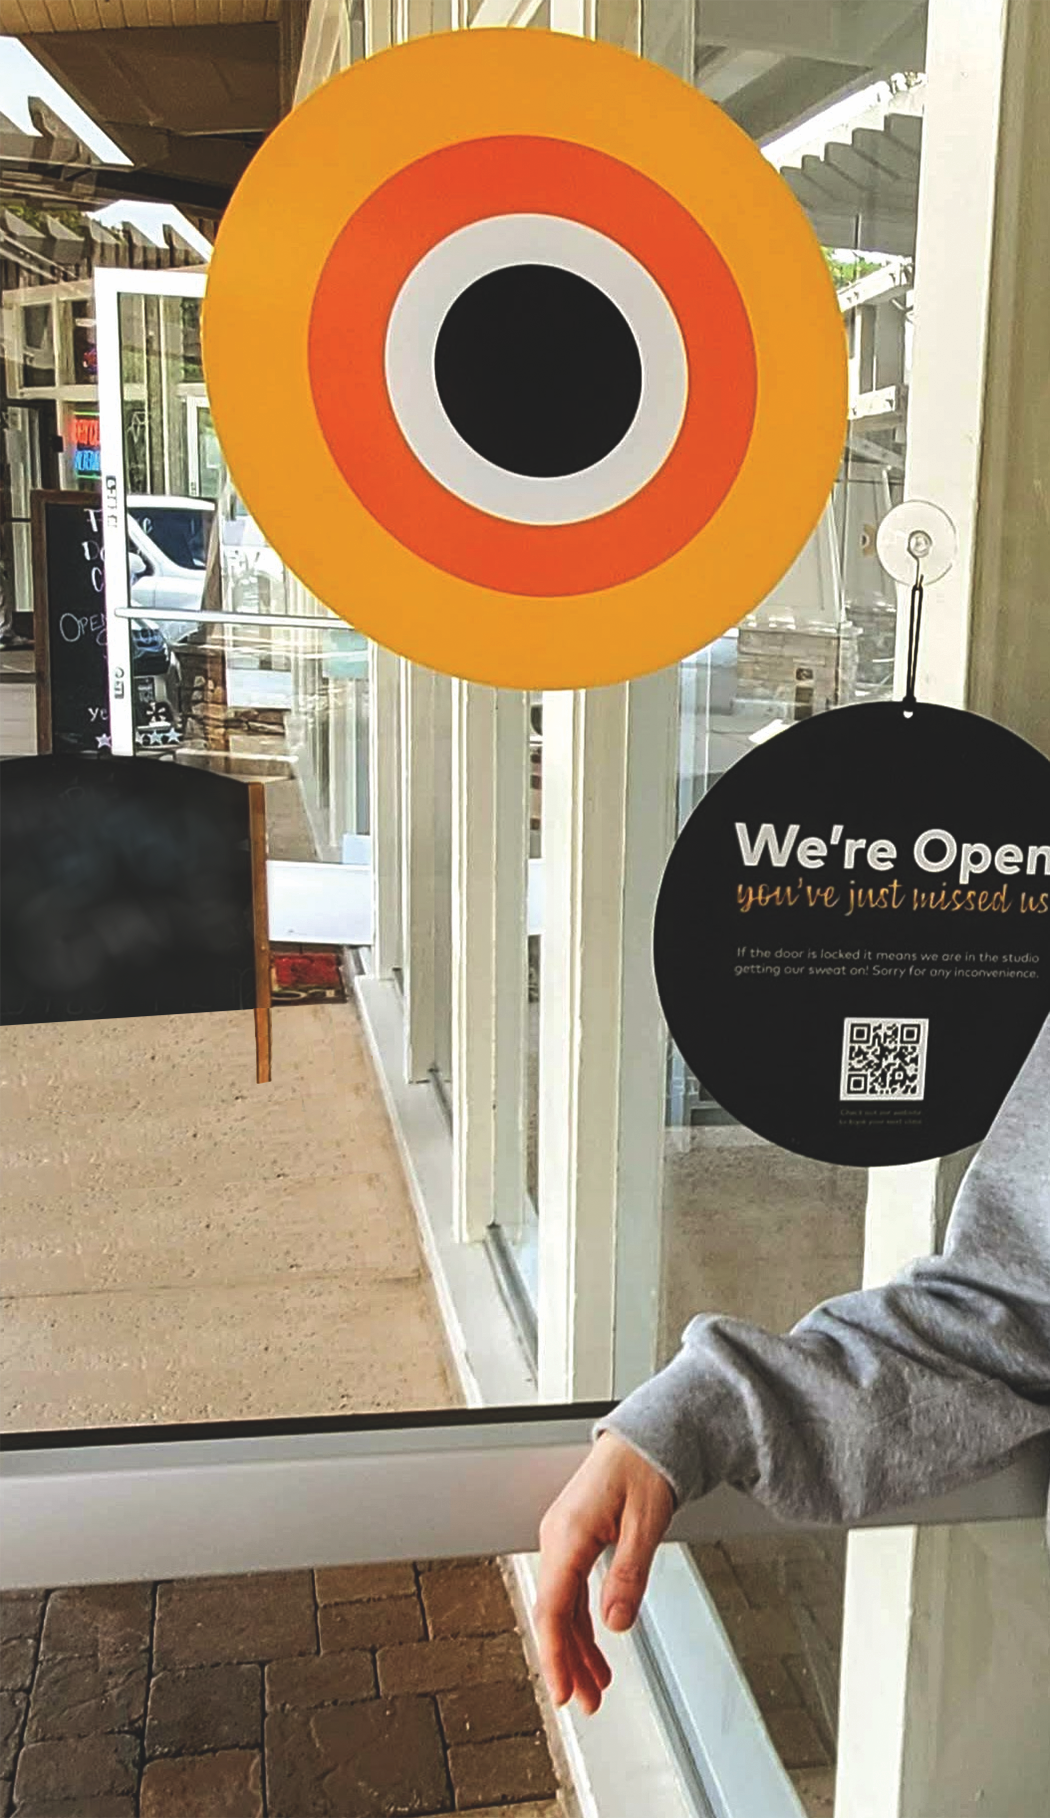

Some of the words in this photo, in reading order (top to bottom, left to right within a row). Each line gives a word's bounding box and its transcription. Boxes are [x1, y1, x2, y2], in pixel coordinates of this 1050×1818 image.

[735, 822, 897, 871] We're
[737, 877, 838, 912] you've
[846, 879, 905, 916] just
[913, 883, 1013, 913] missed
[1020, 892, 1048, 913] us
[737, 946, 747, 958] If
[749, 947, 772, 959] the
[773, 947, 805, 959] door
[807, 948, 818, 960] is
[820, 948, 861, 961] locked
[863, 949, 873, 961] it
[875, 952, 918, 962] means
[920, 953, 939, 962] we
[941, 953, 962, 962] are
[964, 951, 976, 962] in
[978, 951, 999, 963] the
[1001, 952, 1040, 964] studio
[733, 964, 781, 977] getting
[783, 965, 806, 975] our
[808, 965, 847, 976] sweat
[849, 965, 869, 976] on!
[872, 964, 907, 979] Sorry
[908, 964, 927, 977] for
[929, 968, 952, 980] any
[954, 966, 1039, 979] inconvenience.
